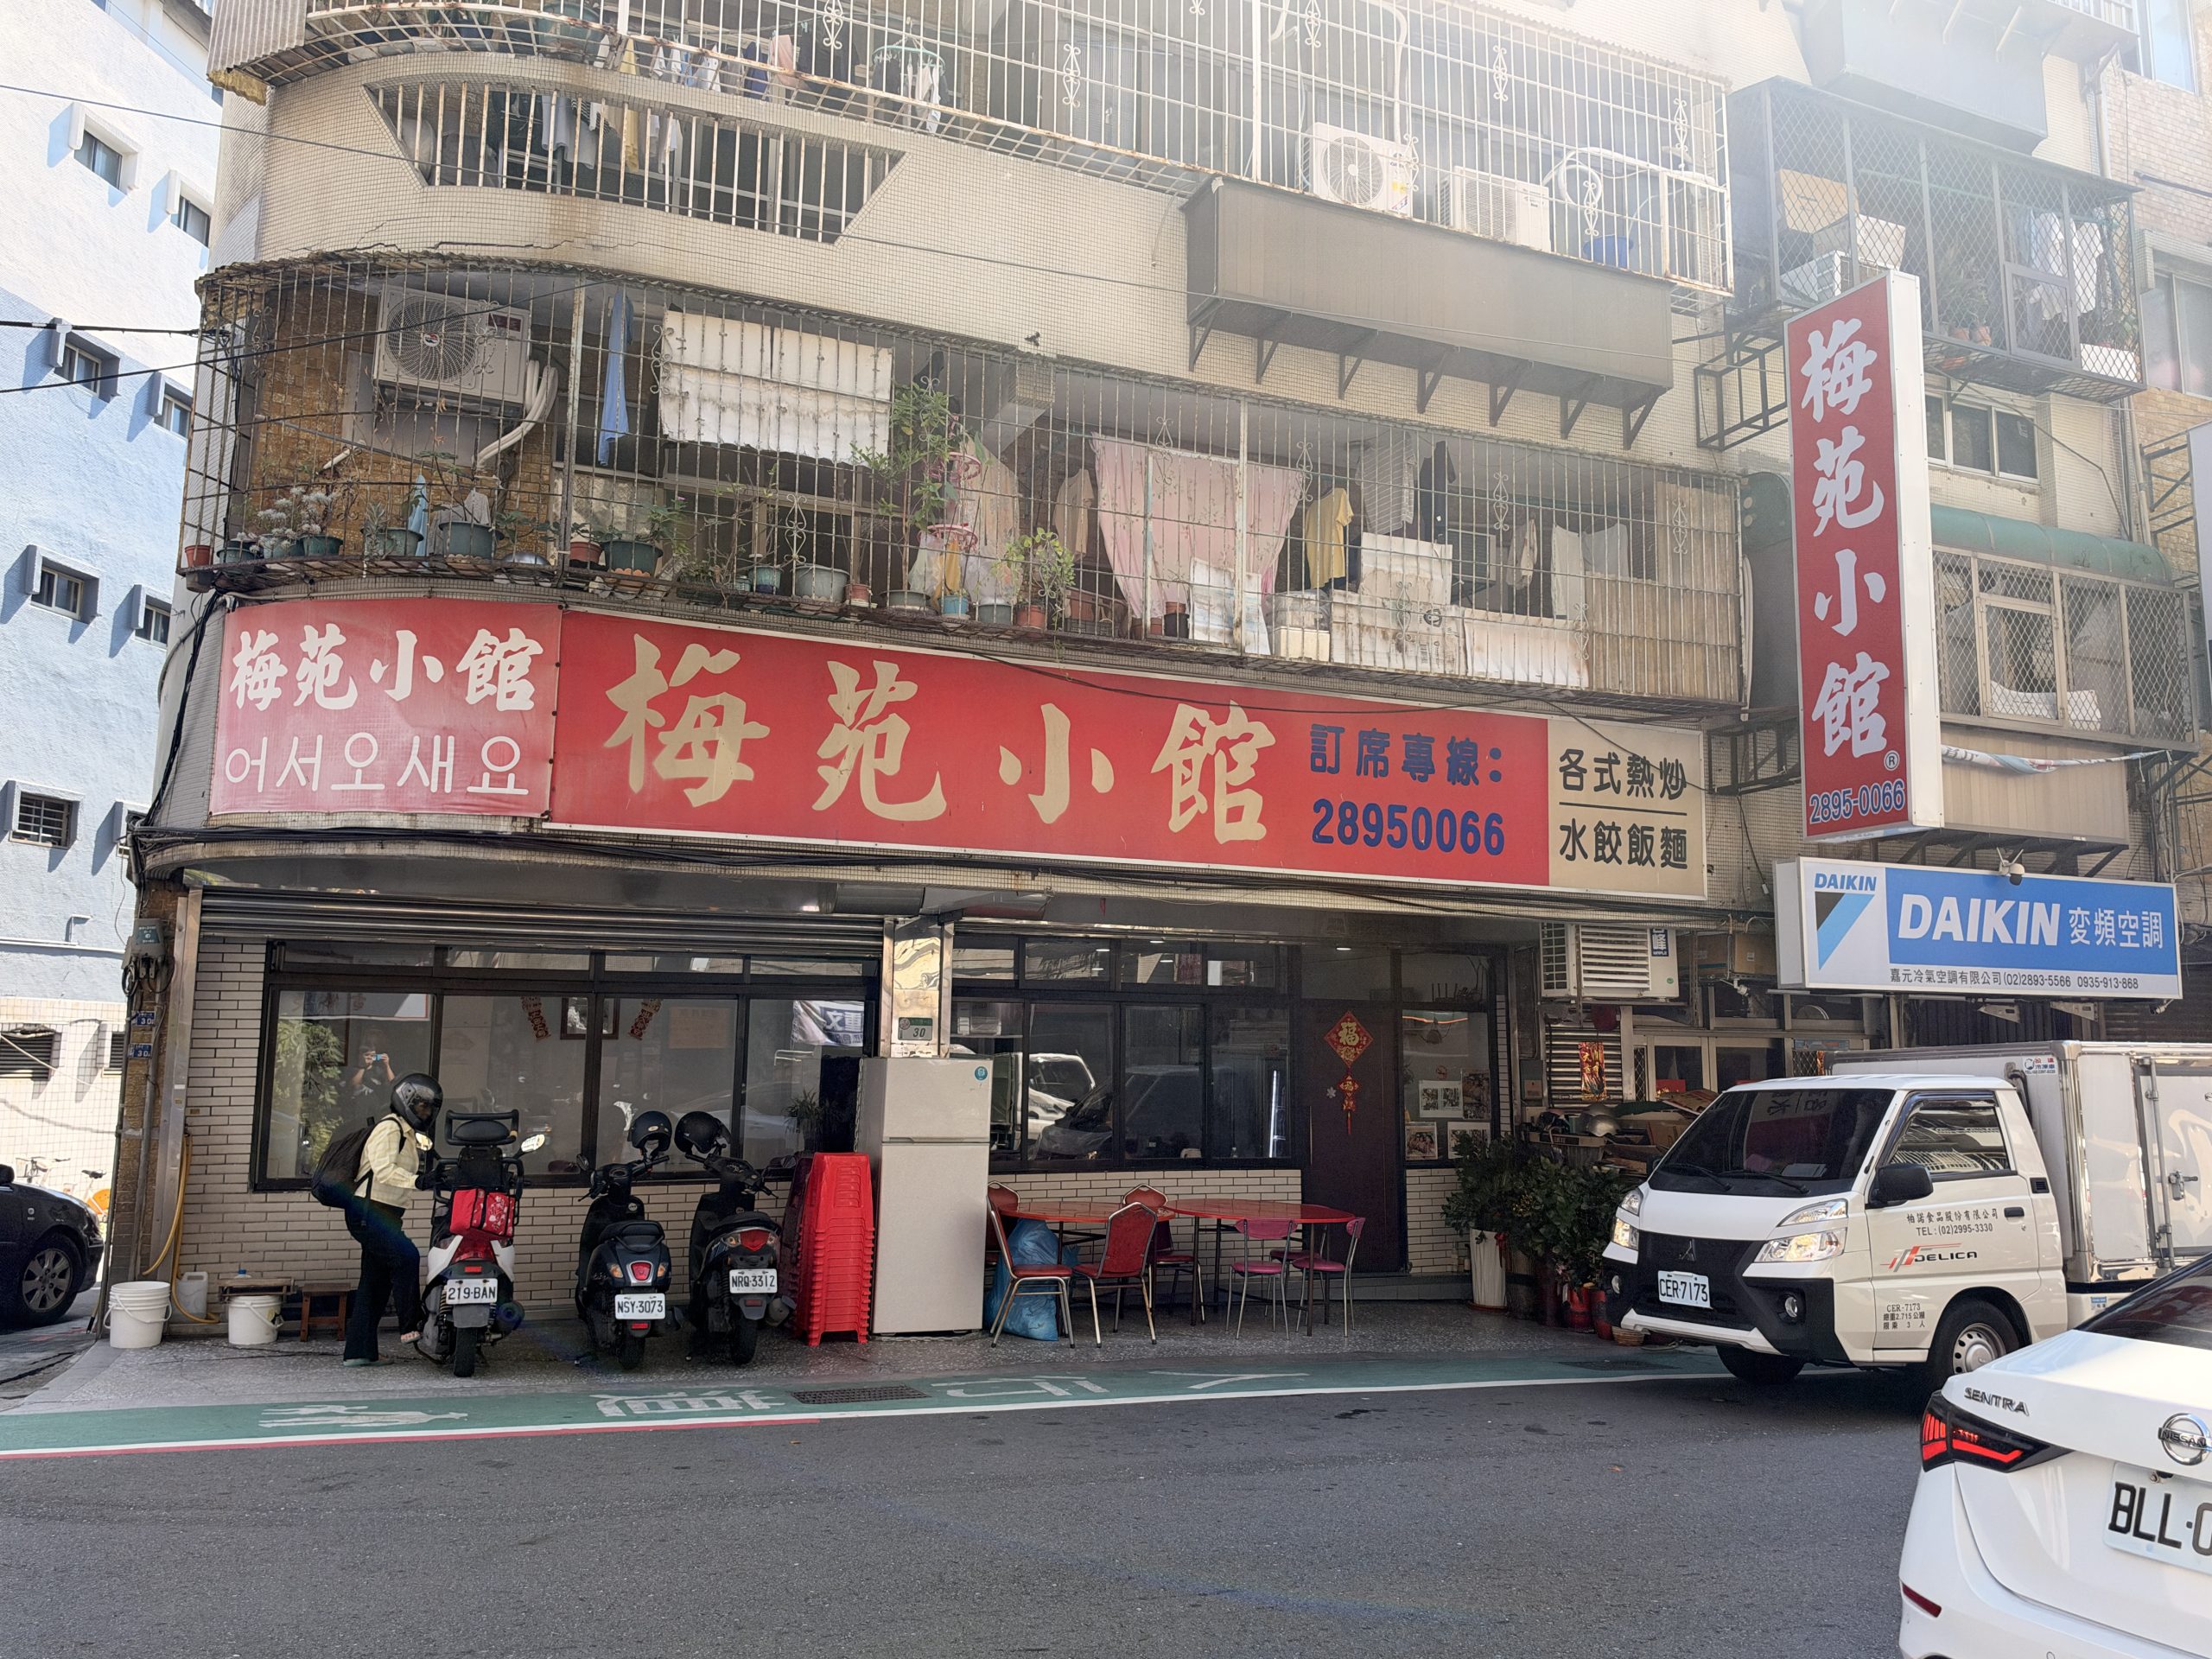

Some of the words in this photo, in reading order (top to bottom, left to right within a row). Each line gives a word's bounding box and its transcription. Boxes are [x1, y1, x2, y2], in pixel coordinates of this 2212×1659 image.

[1800, 318, 1890, 759] 梅苑小館
[229, 623, 544, 712] 梅苑小館
[604, 632, 1276, 844] 梅苑小館
[225, 731, 529, 796] 어서오새요
[1559, 748, 1688, 800] 各式熱炒
[1809, 779, 1905, 823] 2895-0066
[1312, 798, 1504, 855] 28950066
[1559, 818, 1688, 870] 水餃飯麵
[1815, 873, 1877, 891] DAIKIN
[1897, 893, 2060, 946] DAIKIN
[2077, 976, 2139, 989] 0935-913-868
[912, 1027, 926, 1038] 30
[1338, 1021, 1360, 1046] 福
[1914, 1251, 1978, 1262] DELICA
[1886, 1303, 1921, 1313] CER-7173
[1964, 1387, 2030, 1417] SENTRA
[2161, 1427, 2208, 1448] NISSAN
